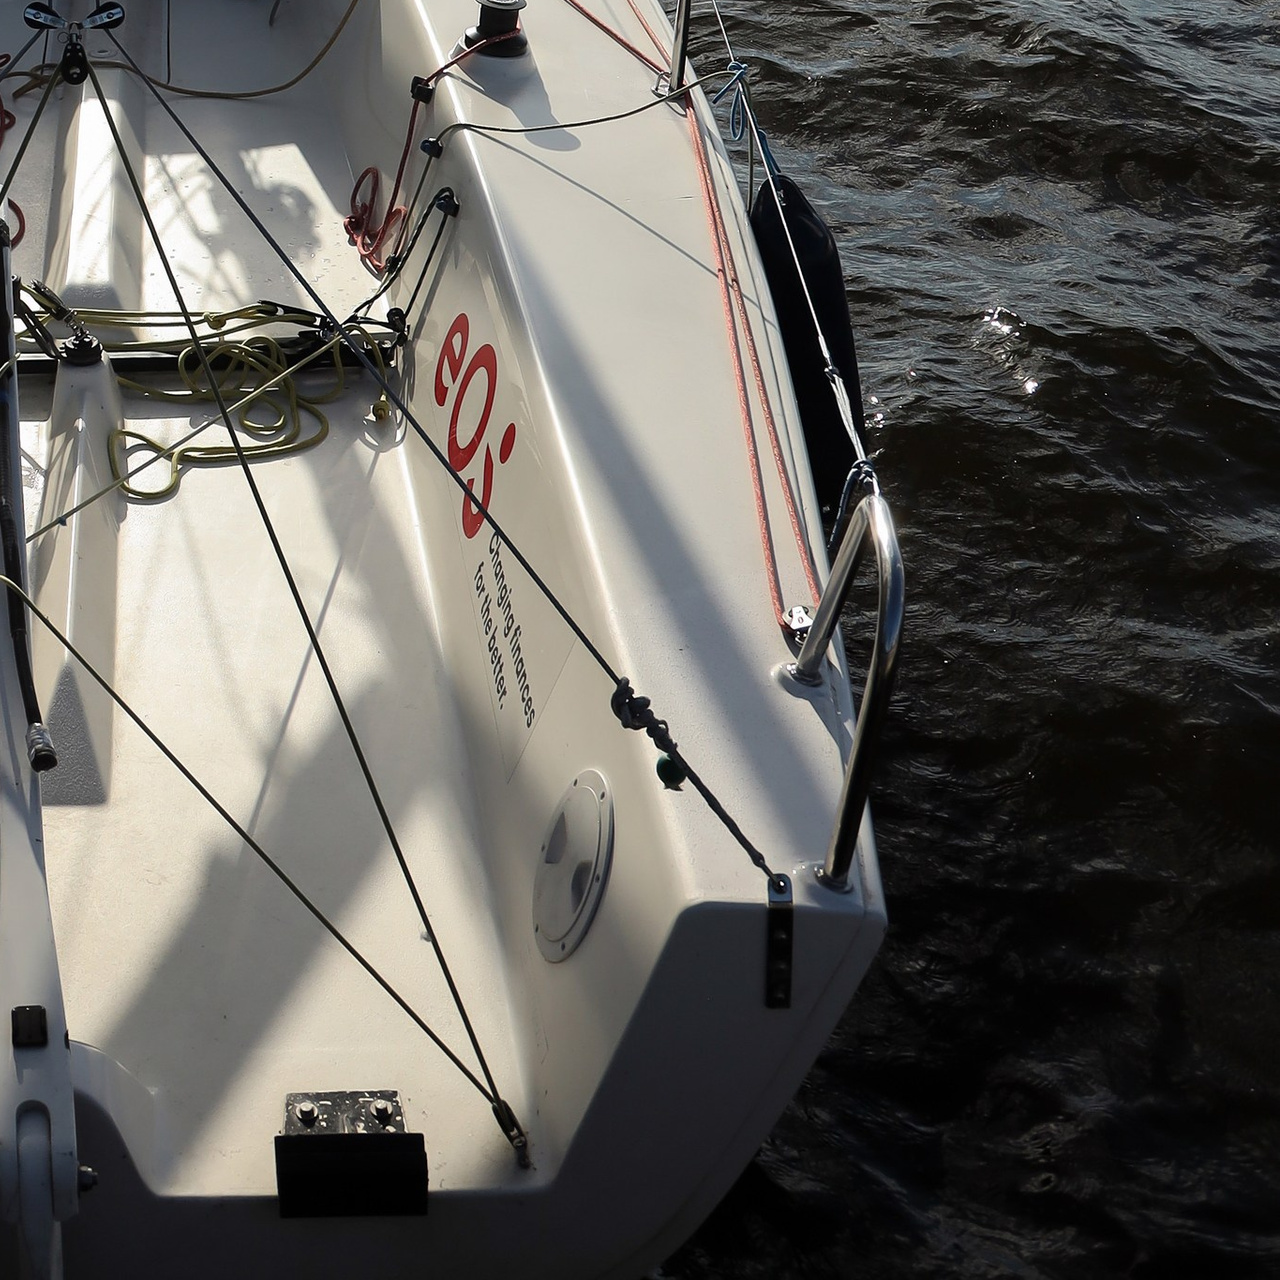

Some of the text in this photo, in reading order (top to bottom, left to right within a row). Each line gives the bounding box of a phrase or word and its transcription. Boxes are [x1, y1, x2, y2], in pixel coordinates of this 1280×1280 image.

[474, 561, 507, 710] for the better.
[489, 531, 535, 728] Changing finances
